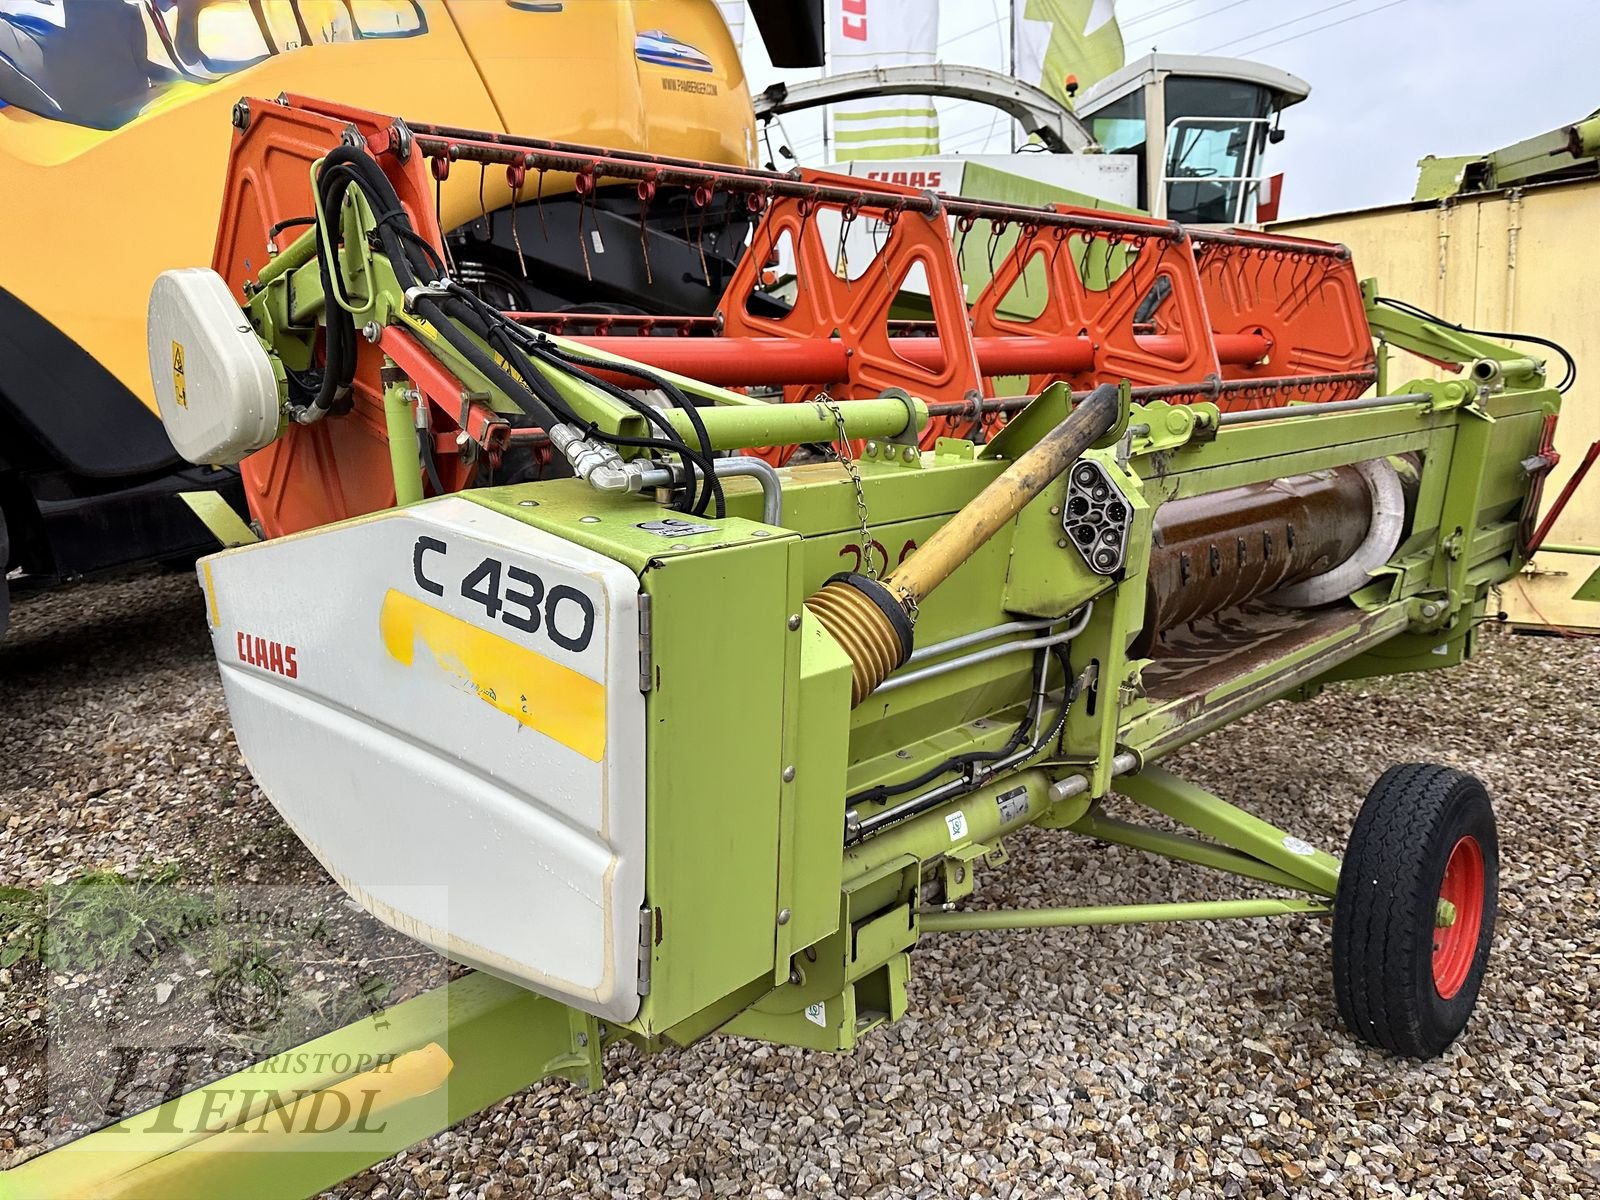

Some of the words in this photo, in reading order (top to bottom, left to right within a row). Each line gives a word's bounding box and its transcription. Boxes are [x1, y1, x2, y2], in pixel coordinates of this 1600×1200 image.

[413, 536, 447, 597] C
[461, 557, 595, 653] 430
[237, 631, 298, 680] CLAAS
